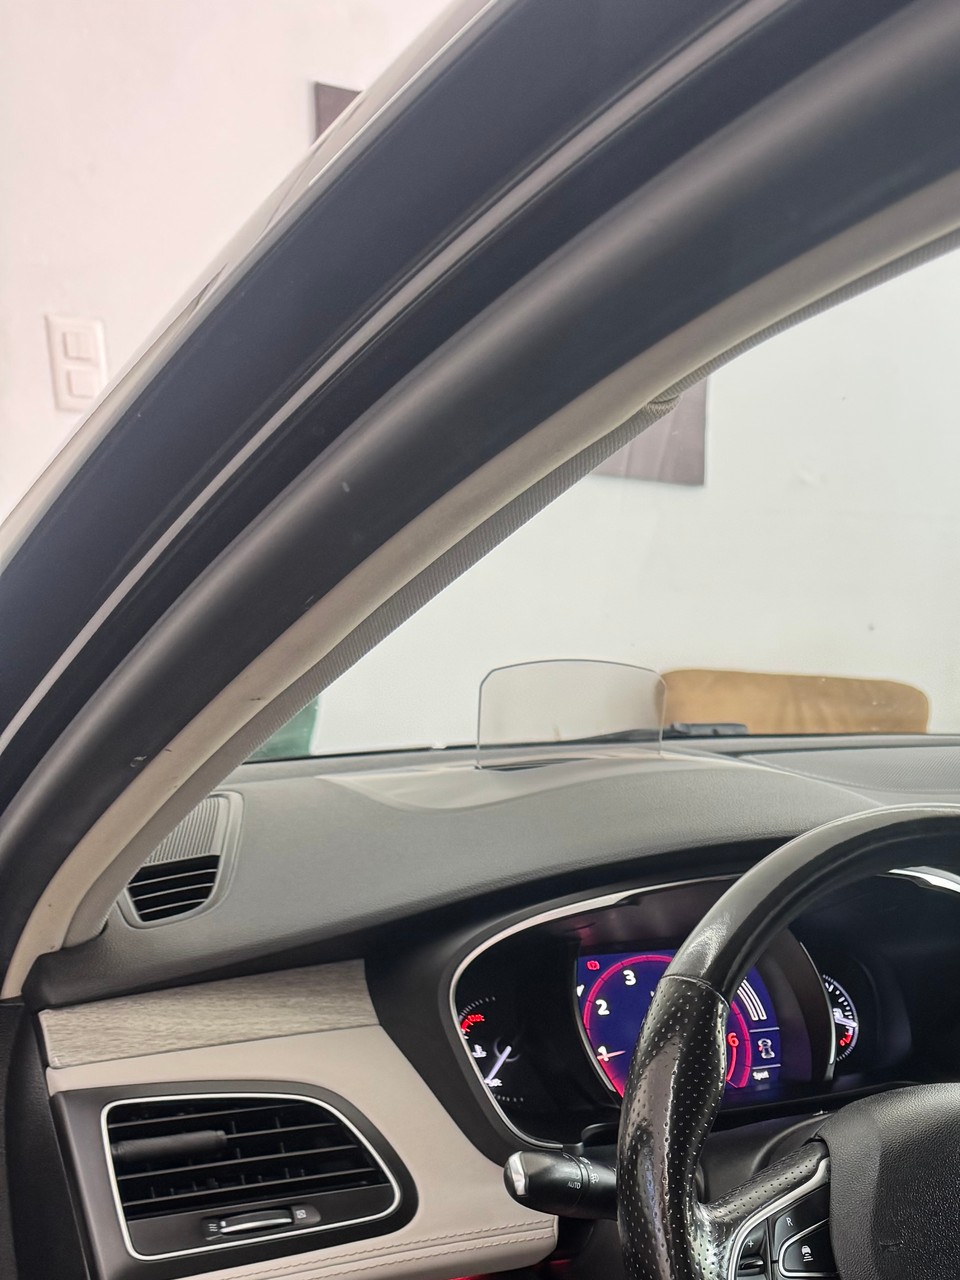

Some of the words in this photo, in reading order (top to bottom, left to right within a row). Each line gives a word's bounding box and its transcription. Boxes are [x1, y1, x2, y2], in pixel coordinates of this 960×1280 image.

[623, 969, 637, 986] 3
[595, 999, 610, 1016] 2
[727, 1032, 739, 1047] 6
[567, 1181, 581, 1190] AUTO
[786, 1217, 794, 1227] R
